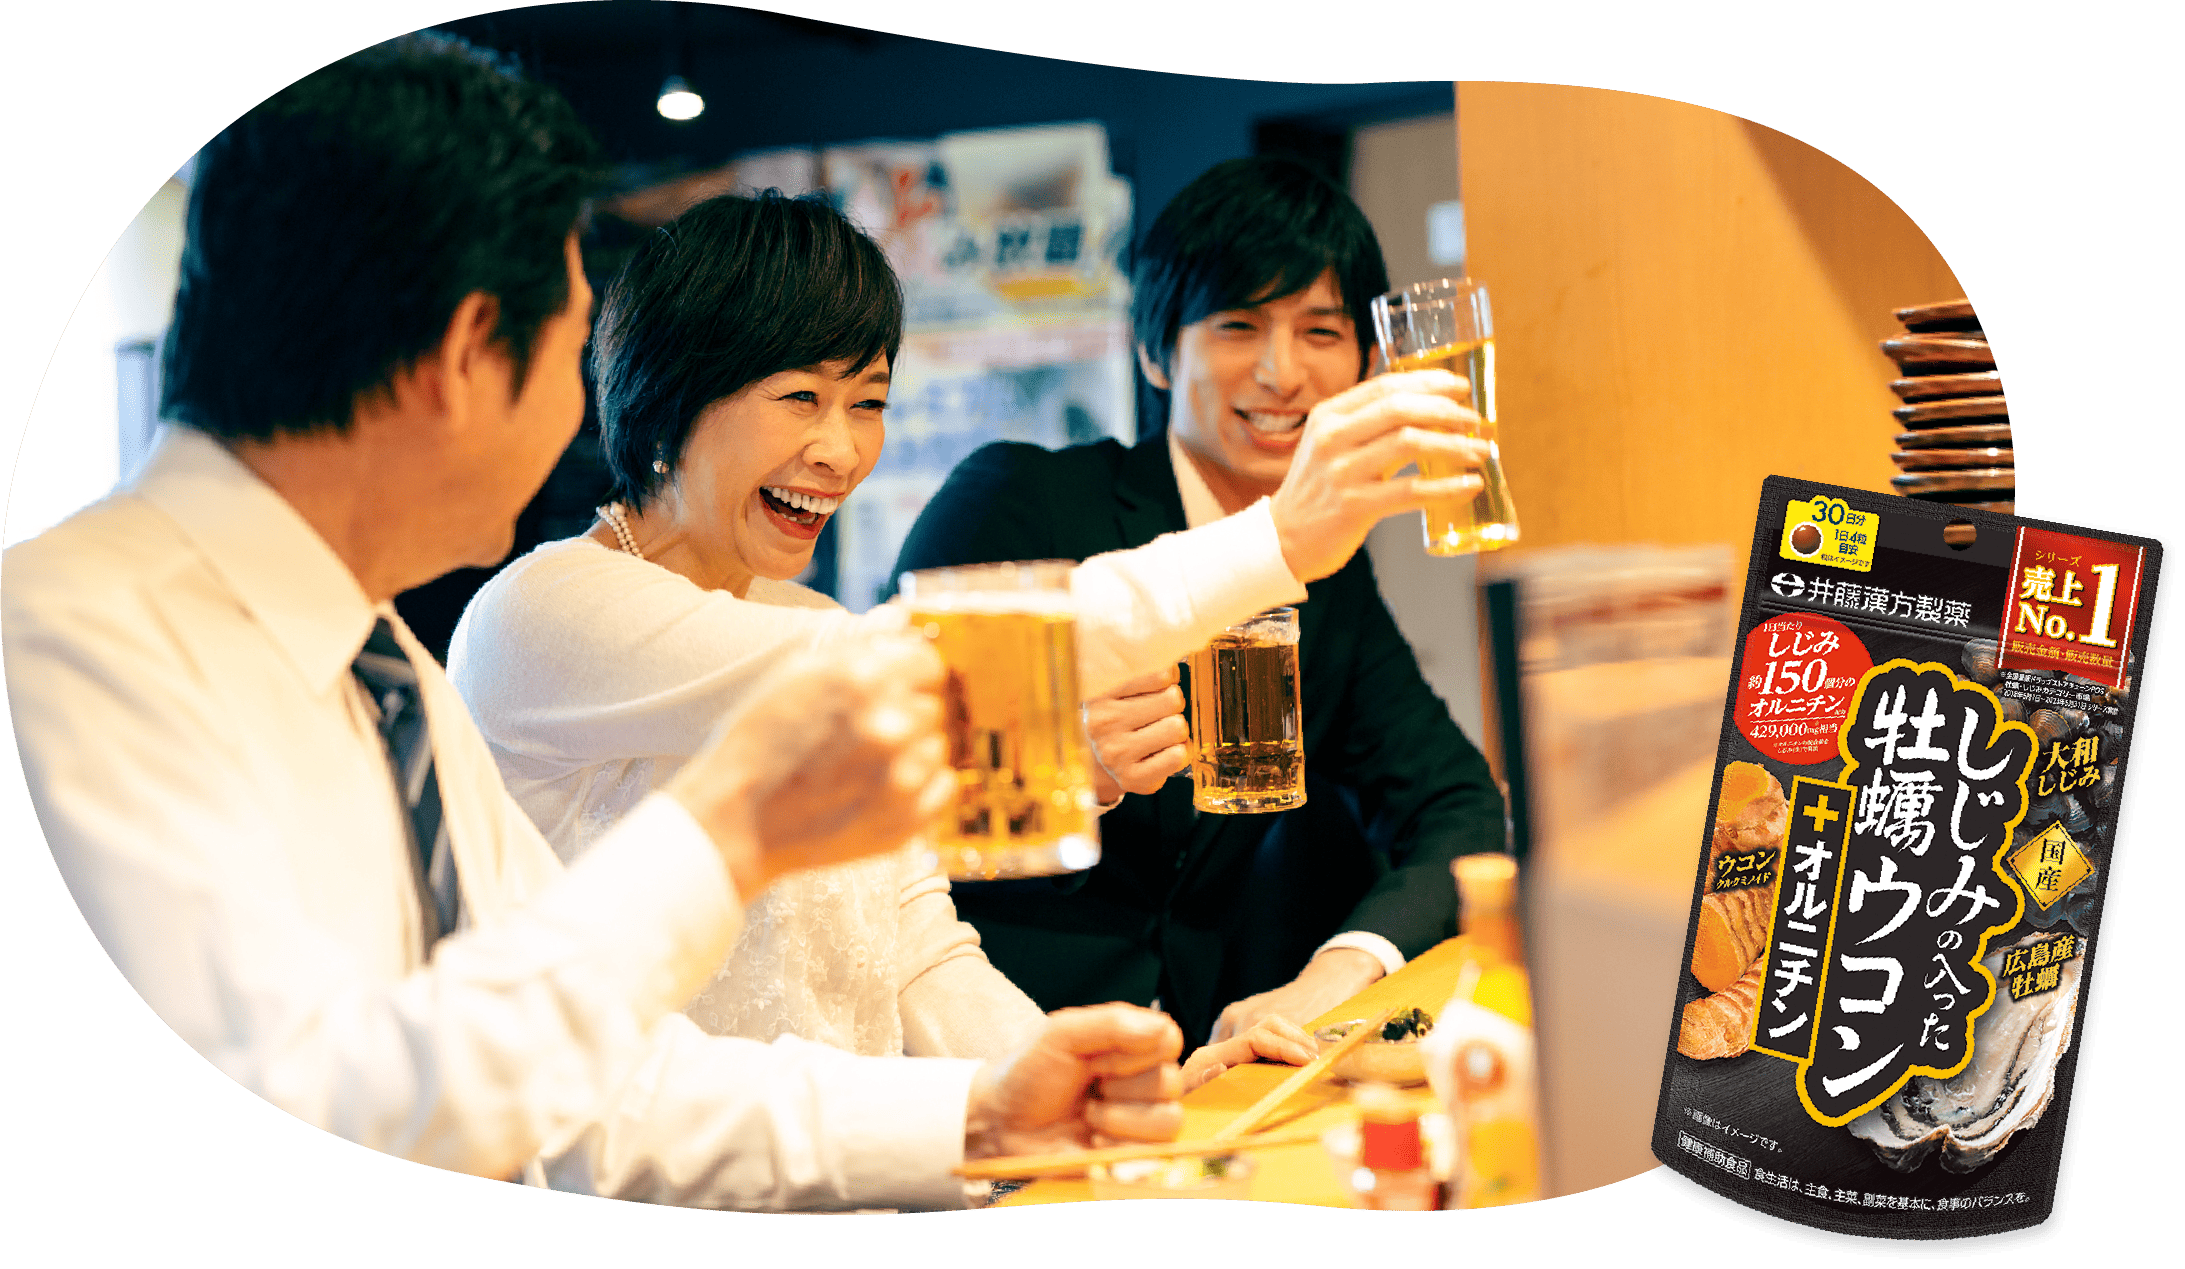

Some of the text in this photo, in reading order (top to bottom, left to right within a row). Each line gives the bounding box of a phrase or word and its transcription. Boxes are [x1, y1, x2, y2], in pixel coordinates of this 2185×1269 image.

[1811, 501, 1867, 526] 30日分
[1835, 529, 1868, 545] 1日4粒
[1839, 543, 1859, 556] 目安
[2035, 550, 2083, 567] シリーズ
[2019, 565, 2085, 608] 売上
[1808, 576, 1972, 628] 井藤漢方製薬
[1763, 620, 1803, 633] 1日当たり
[1768, 631, 1841, 658] しじみ
[1747, 694, 1846, 718] オルニチン
[2042, 735, 2100, 773] 大和
[2038, 765, 2101, 797] しじみ
[1718, 850, 1777, 878] ウコン
[2035, 838, 2067, 892] 国産
[1715, 872, 1772, 890] クルクミノイド
[1823, 684, 1950, 1098] 牡蠣ウコン
[2002, 934, 2076, 976] 広島産
[2011, 963, 2060, 999] 牡蠣
[1680, 1134, 1749, 1176] 健康補助食品
